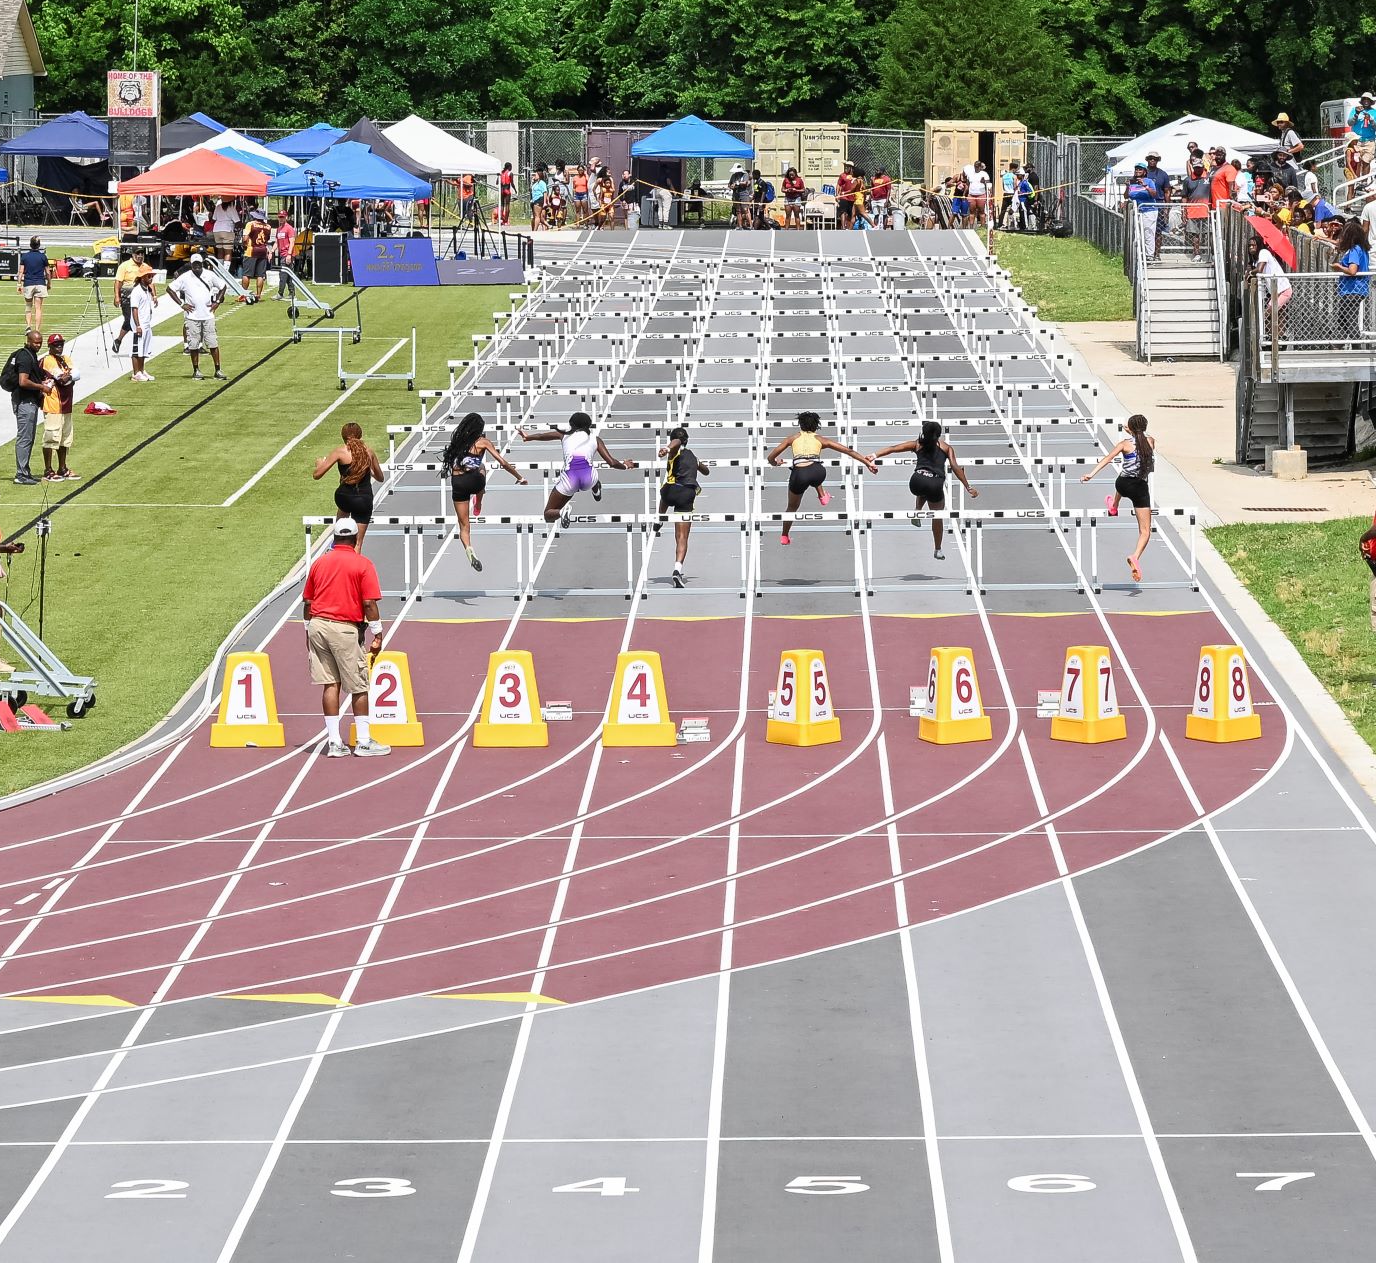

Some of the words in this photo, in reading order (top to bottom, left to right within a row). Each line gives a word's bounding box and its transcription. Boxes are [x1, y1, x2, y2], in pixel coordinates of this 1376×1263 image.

[109, 107, 153, 116] BULLDOGS
[375, 244, 406, 259] 2.7
[456, 267, 505, 275] 2.7
[237, 674, 252, 708] 1
[375, 673, 397, 707] 2
[499, 673, 521, 708] 3
[627, 673, 650, 707] 4
[780, 671, 794, 706] 5
[813, 670, 826, 706] 5
[928, 668, 936, 703] 6
[955, 668, 973, 703] 6
[1066, 668, 1080, 702] 7
[1100, 667, 1111, 702] 7
[1199, 666, 1210, 702] 8
[1232, 666, 1245, 702] 8
[104, 1180, 189, 1198] 2
[331, 1178, 416, 1197] 3
[552, 1177, 640, 1196] 4
[784, 1176, 870, 1194] 5
[1007, 1174, 1096, 1193] 6
[1236, 1172, 1315, 1190] 7
